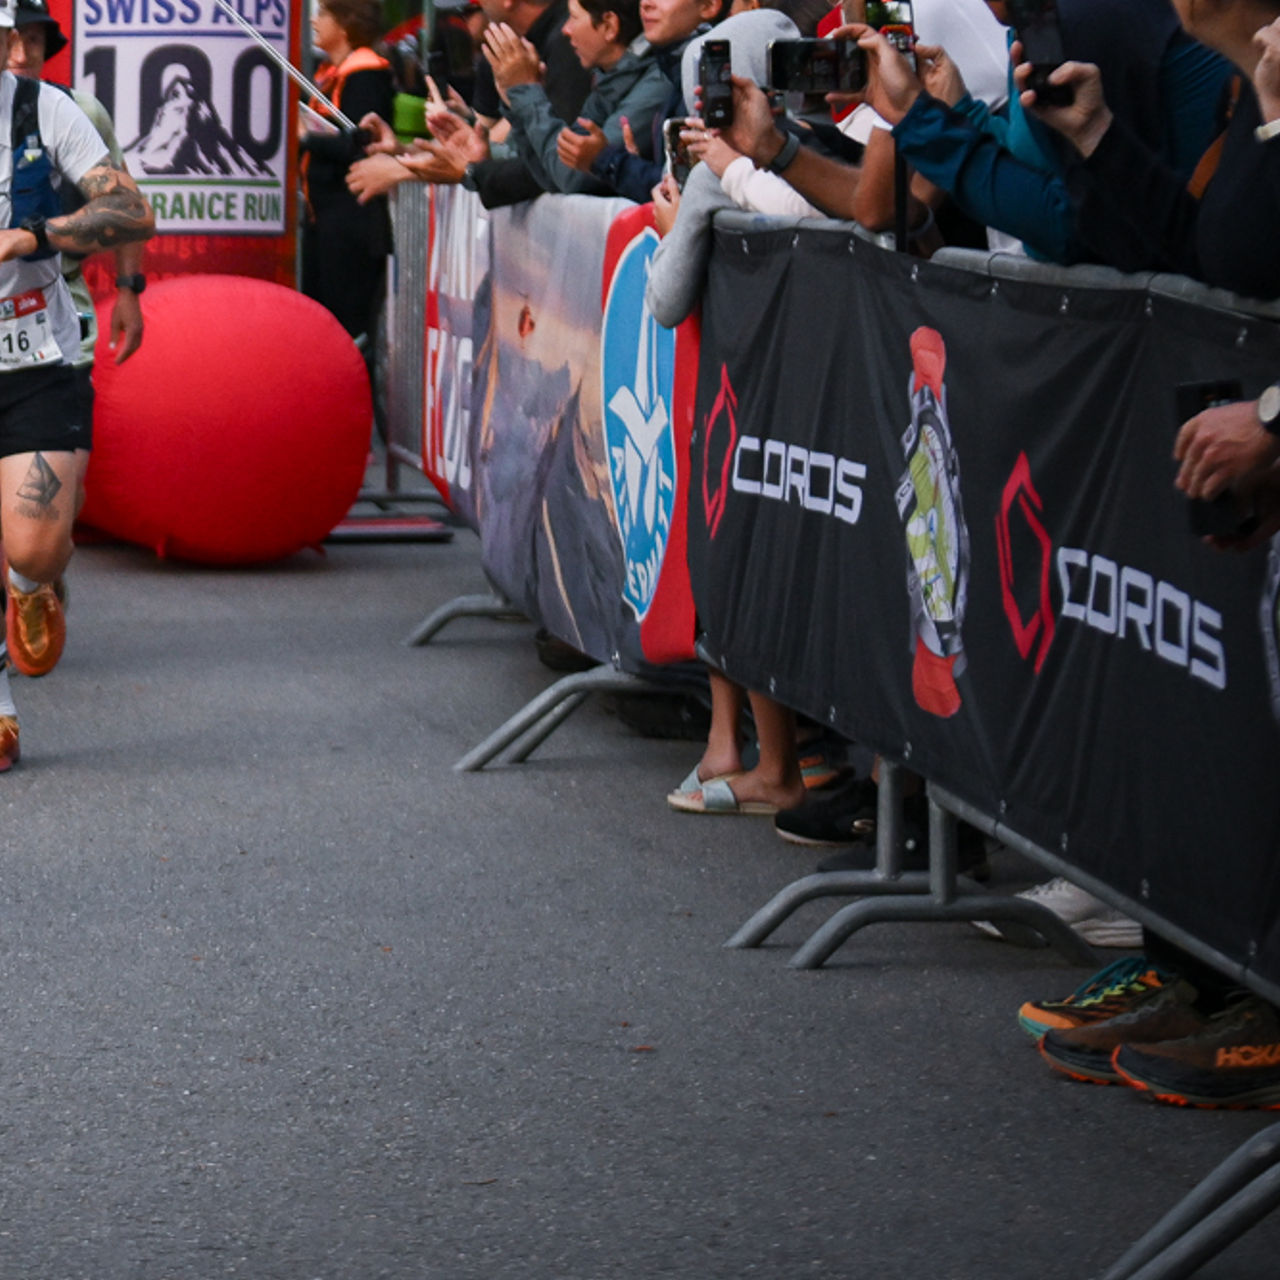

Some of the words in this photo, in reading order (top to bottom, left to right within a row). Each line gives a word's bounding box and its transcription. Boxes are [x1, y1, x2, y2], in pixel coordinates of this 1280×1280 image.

[82, 43, 284, 163] 100
[243, 193, 283, 221] RUN
[732, 433, 868, 525] COROS
[1056, 546, 1229, 691] COROS
